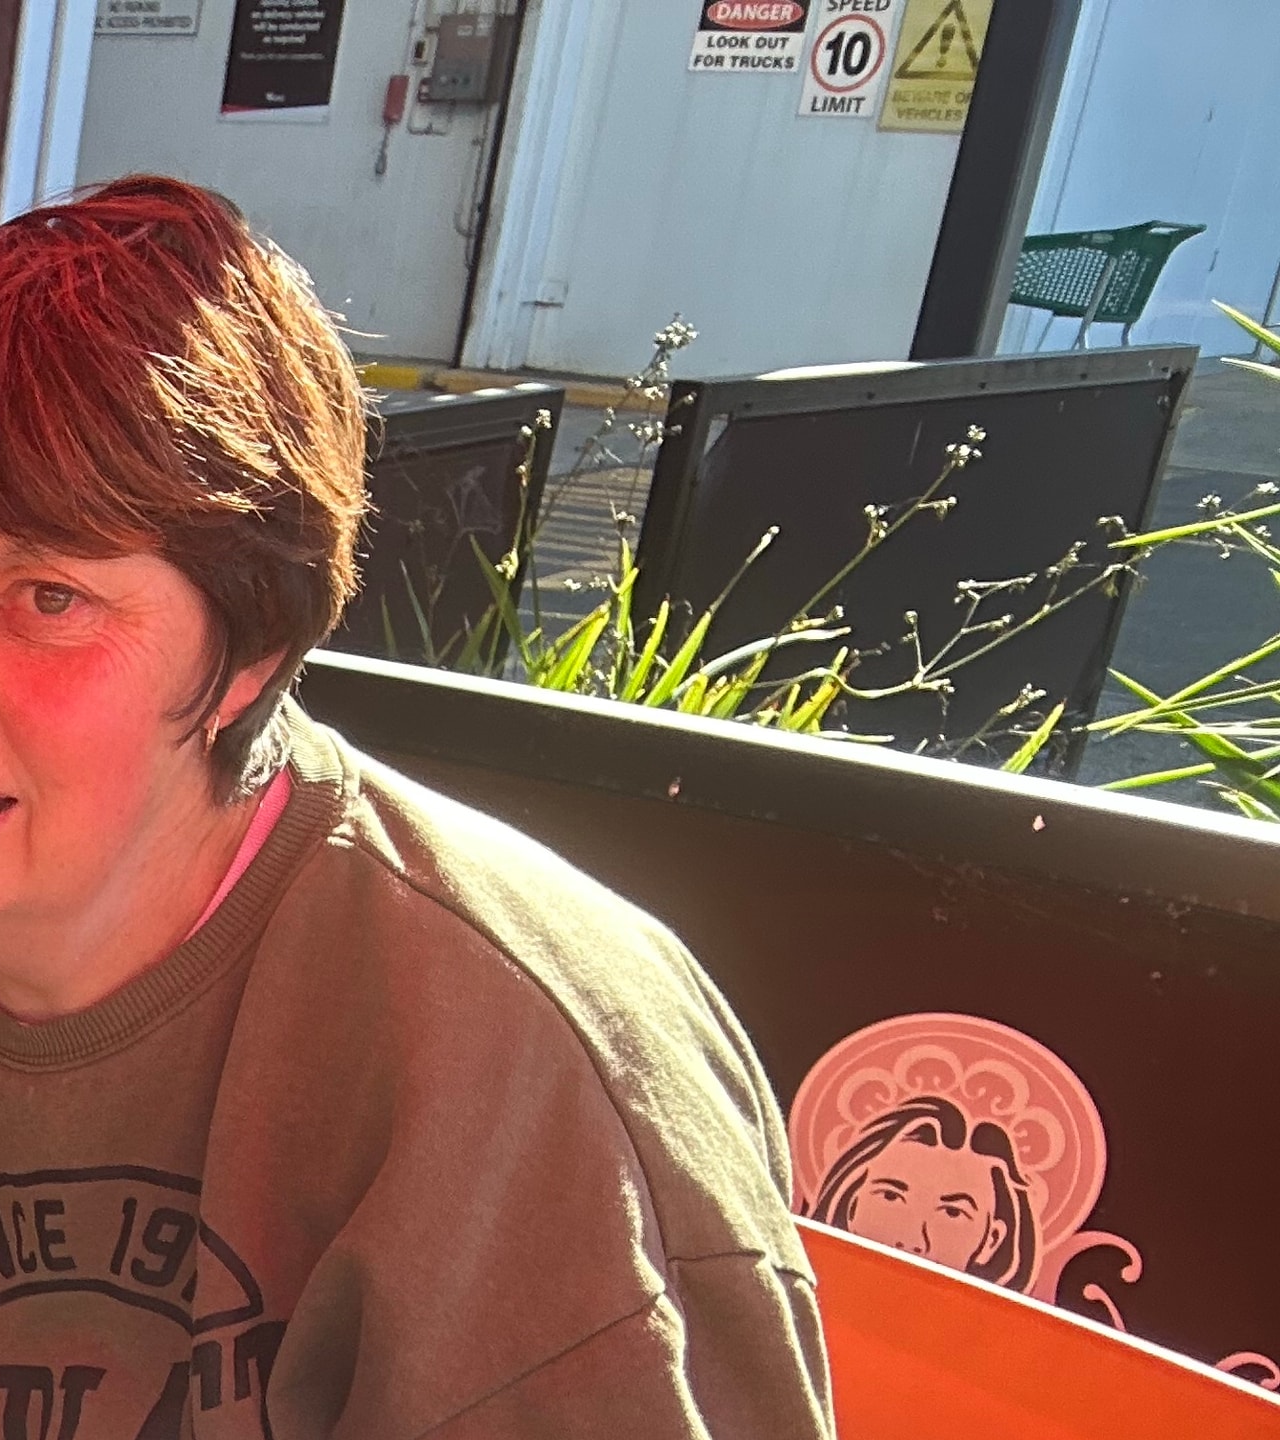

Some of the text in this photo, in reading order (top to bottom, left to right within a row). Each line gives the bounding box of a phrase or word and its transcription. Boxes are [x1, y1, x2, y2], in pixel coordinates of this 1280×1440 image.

[716, 2, 794, 21] DANGER
[827, 0, 889, 12] SPEED
[707, 36, 790, 49] LOOK OUT
[825, 31, 872, 77] 10
[693, 55, 795, 69] FOR TRUCKS
[811, 97, 866, 114] LIMIT
[897, 107, 963, 121] VEHICLES
